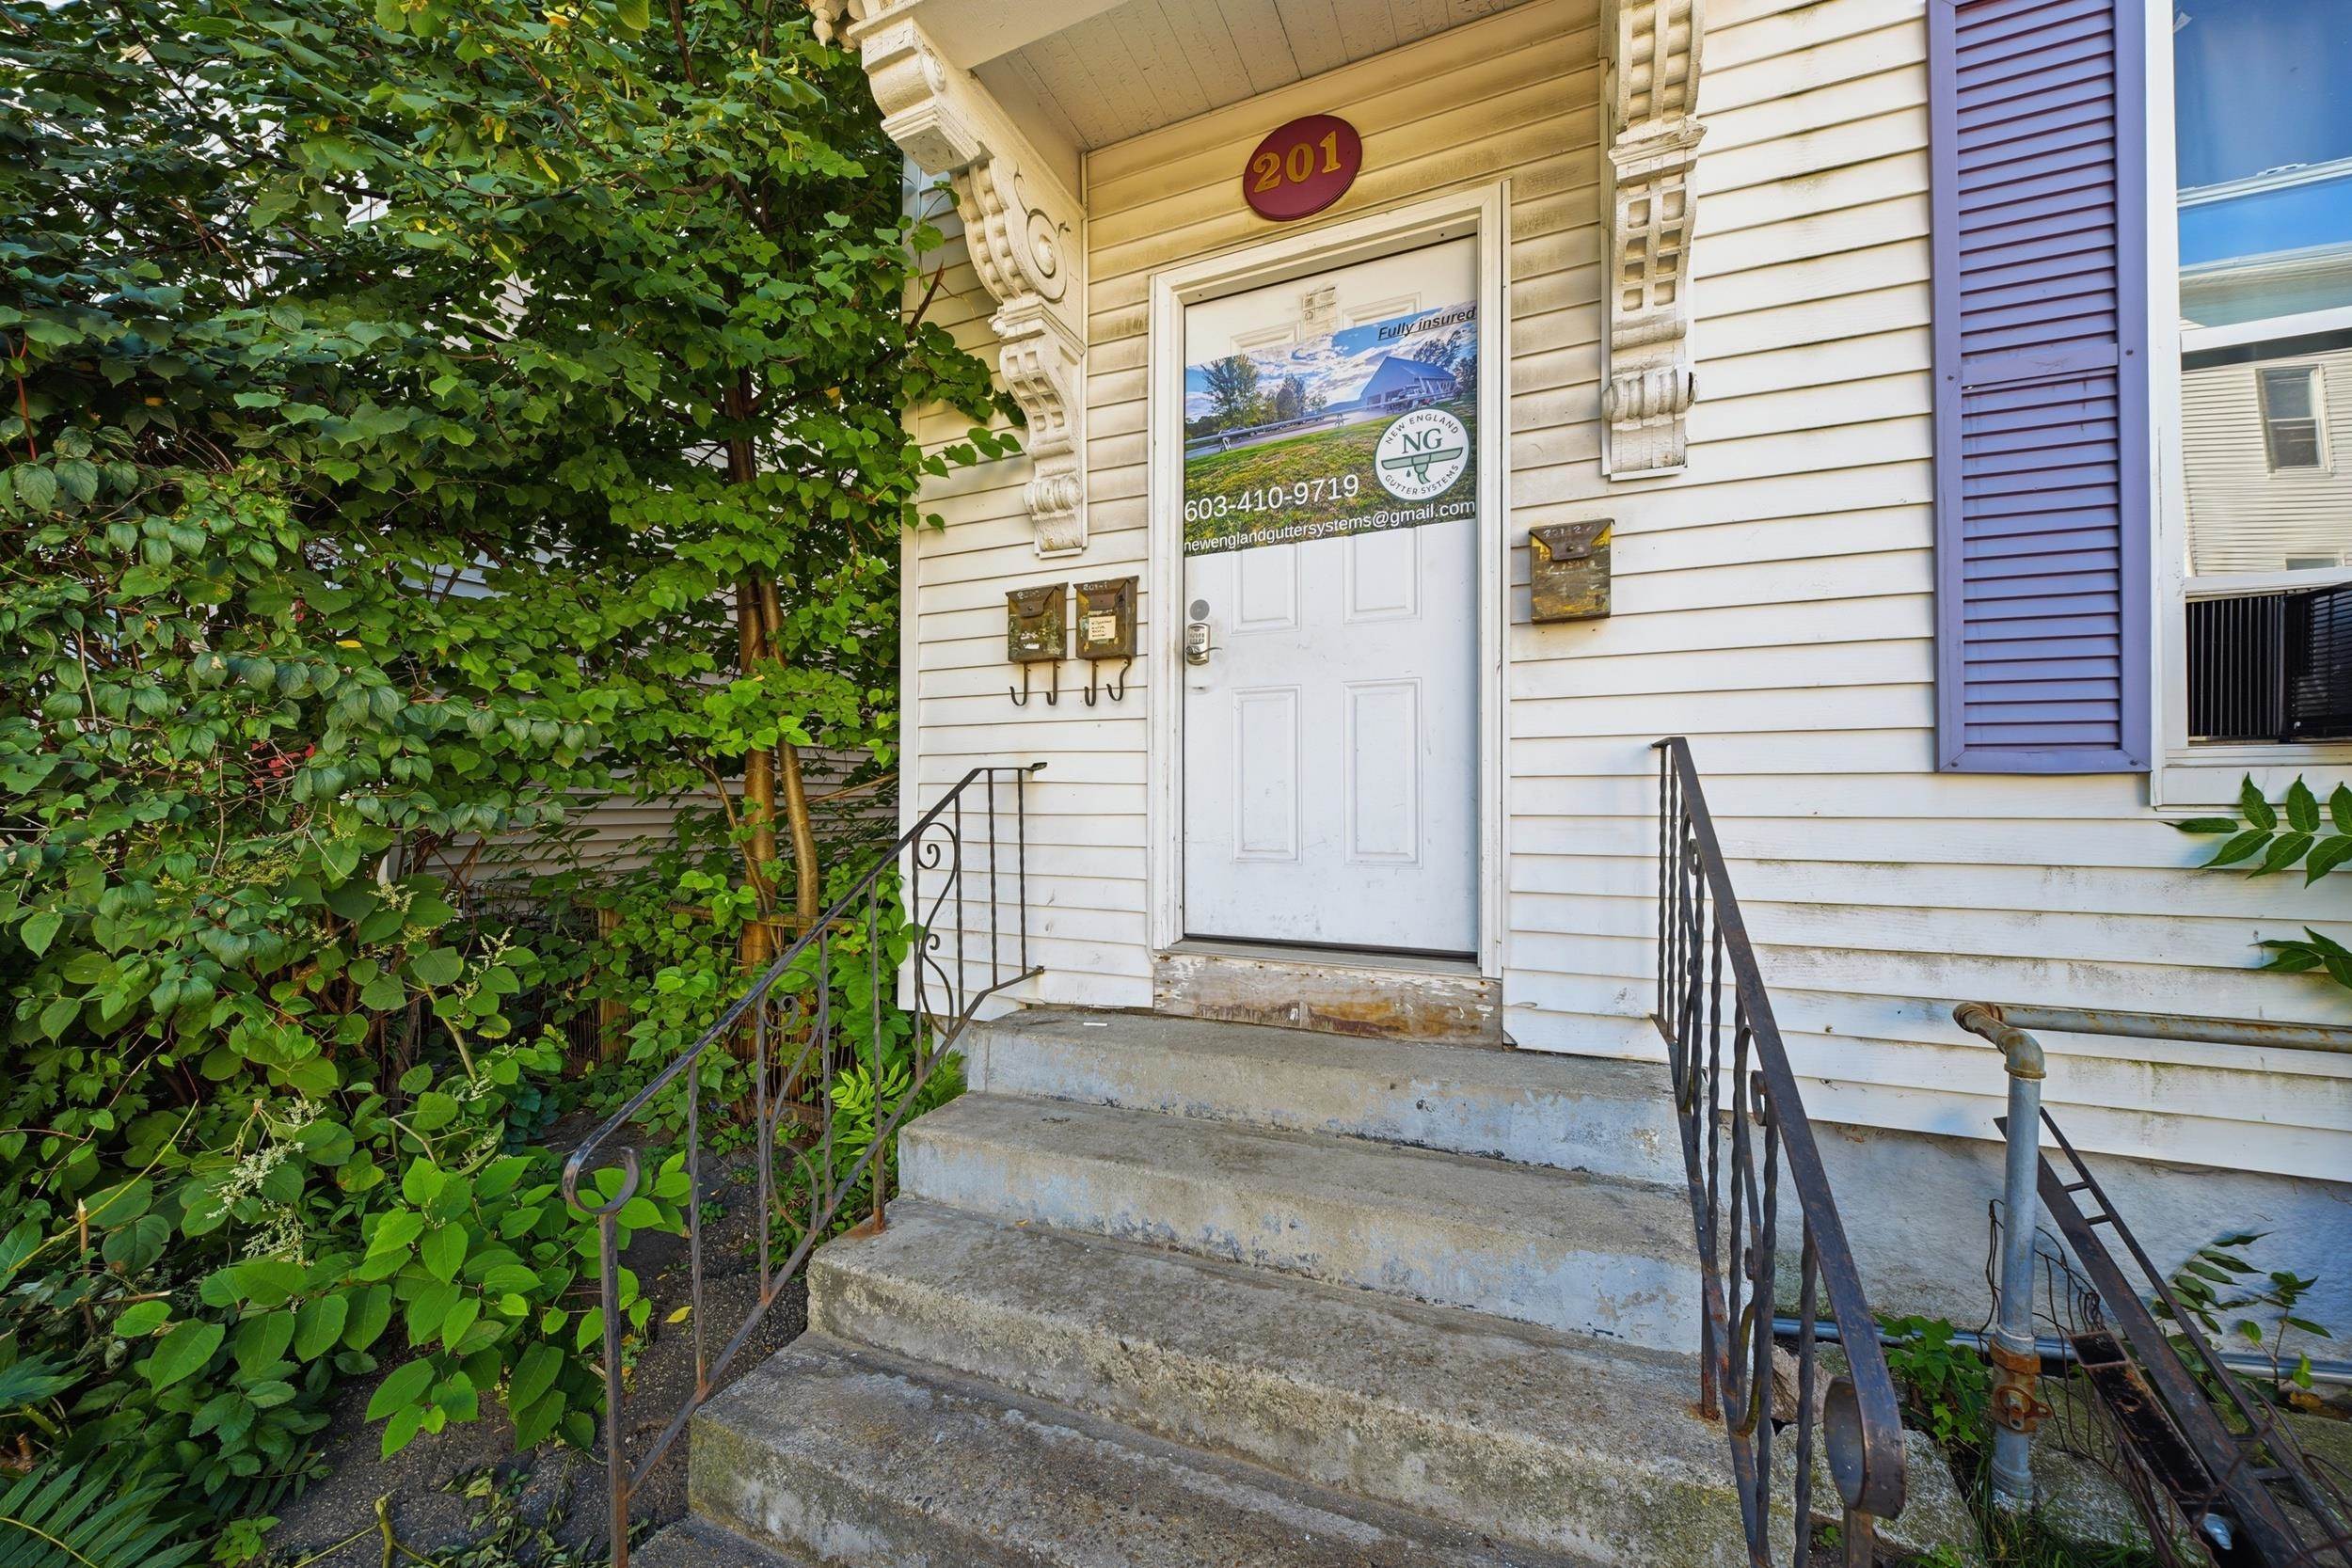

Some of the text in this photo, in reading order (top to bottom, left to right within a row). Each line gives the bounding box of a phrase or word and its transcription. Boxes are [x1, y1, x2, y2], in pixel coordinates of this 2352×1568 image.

[1253, 130, 1342, 193] 201
[1378, 307, 1476, 340] Fully insured
[1386, 414, 1458, 444] NEW ENGLAND
[1401, 428, 1443, 453] NG
[1385, 465, 1459, 495] GUTTER SYSTEMS
[1184, 474, 1359, 522] 603-410-9719
[1184, 500, 1475, 552] newenglandguttersystems@gmail.com
